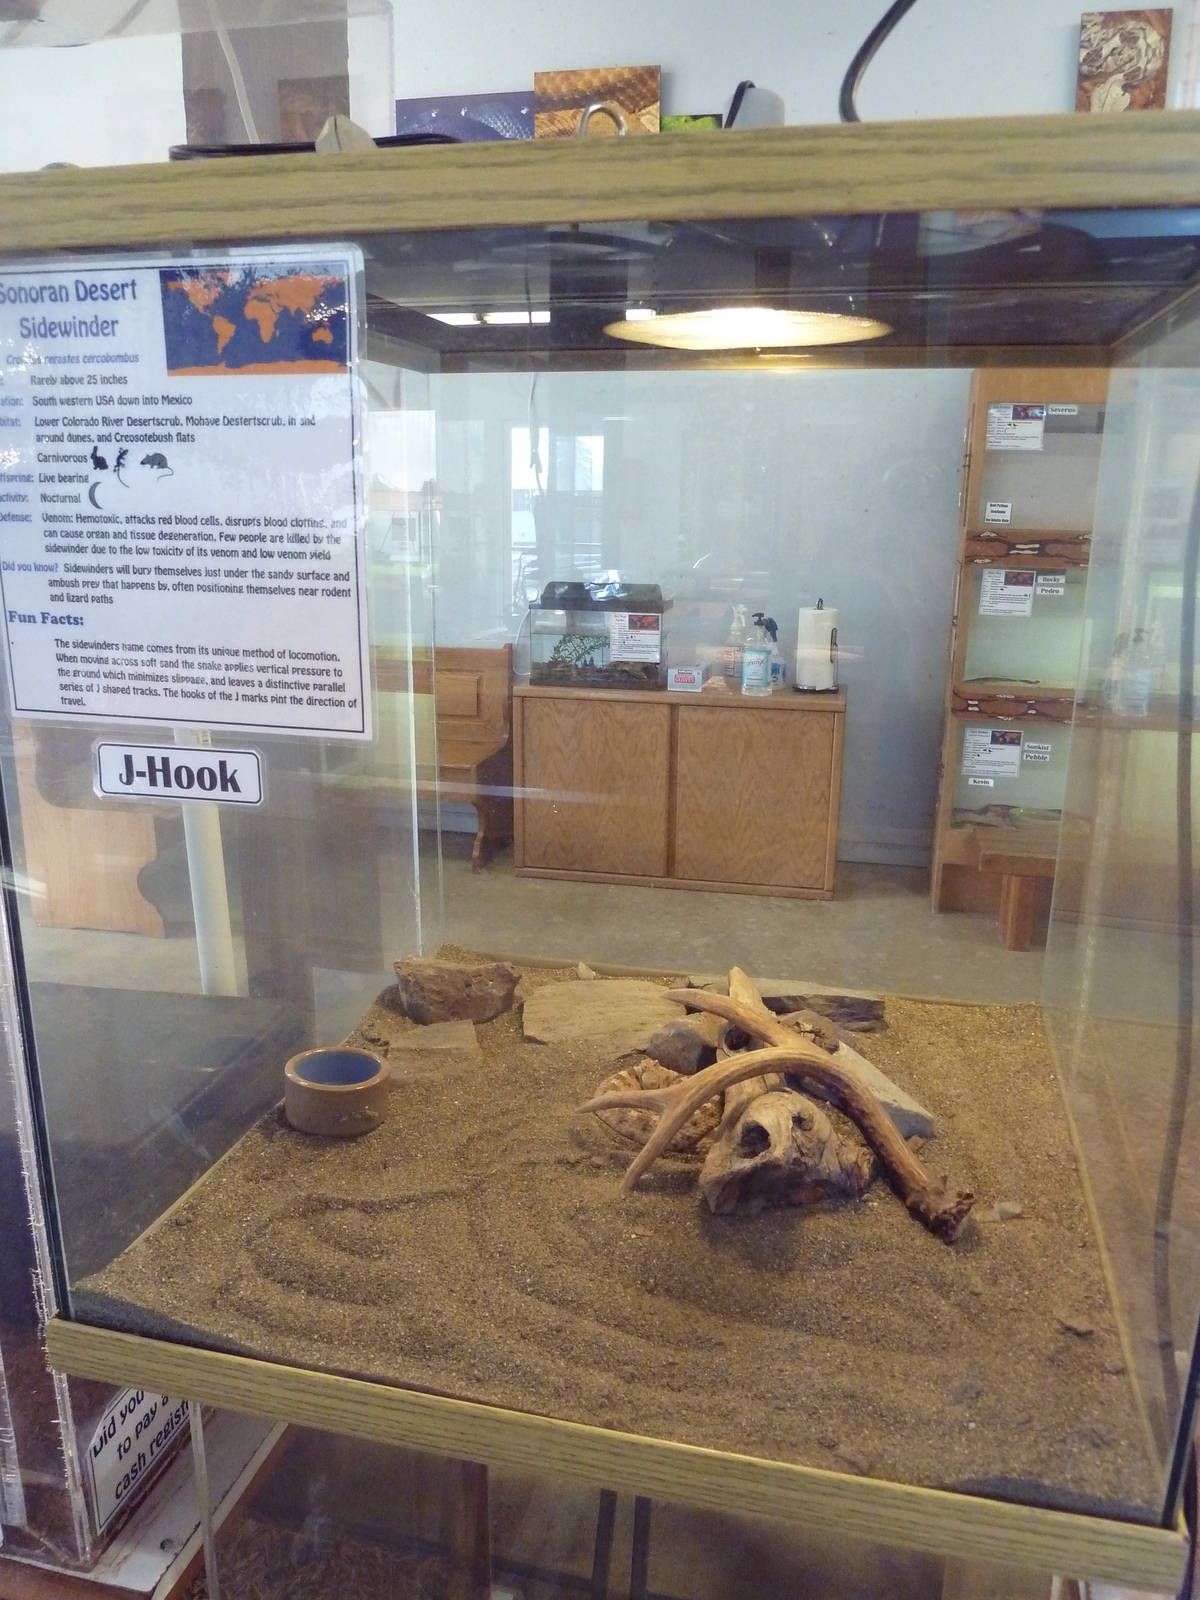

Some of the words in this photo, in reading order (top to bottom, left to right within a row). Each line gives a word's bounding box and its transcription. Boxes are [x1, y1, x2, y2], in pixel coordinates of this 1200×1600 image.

[0, 281, 69, 305] Sonoran
[75, 279, 138, 302] Desert
[20, 314, 119, 339] Sidewinder
[30, 375, 57, 387] Rarely
[60, 375, 85, 386] above
[87, 374, 98, 385] 25
[100, 373, 128, 386] inches
[32, 394, 58, 407] South
[60, 396, 93, 407] western
[95, 394, 115, 406] USA
[118, 394, 140, 406] down
[142, 394, 159, 406] into
[161, 394, 193, 406] Mexico
[34, 415, 60, 428] Lower
[62, 415, 99, 427] Colorado
[102, 415, 124, 427] River
[185, 415, 220, 427] Mohave
[288, 415, 297, 427] in
[299, 415, 316, 427] and
[36, 432, 65, 444] around
[97, 431, 112, 443] and
[114, 431, 173, 444] Creosotebush
[175, 431, 196, 444] flats
[37, 451, 88, 464] Carnivorous
[38, 472, 56, 484] Live
[58, 472, 89, 485] bearing
[40, 492, 81, 504] Nocturnal
[42, 512, 74, 524] Venom:
[125, 514, 156, 526] attacks
[158, 515, 173, 526] red
[175, 515, 198, 527] blood
[225, 516, 261, 528] disrupts
[263, 516, 288, 528] blood
[43, 530, 58, 539] can
[60, 530, 85, 540] cause
[86, 531, 111, 541] organ
[112, 529, 127, 540] and
[130, 530, 156, 541] tissue
[219, 531, 237, 542] Few
[238, 533, 267, 545] people
[269, 535, 285, 544] are
[286, 532, 310, 544] killed
[312, 534, 324, 546] by
[326, 534, 342, 545] the
[44, 542, 89, 554] sidewinder
[91, 543, 106, 555] due
[108, 545, 118, 555] to
[119, 545, 133, 556] the
[135, 545, 150, 556] low
[152, 545, 184, 558] toxicity
[186, 546, 195, 557] of
[197, 547, 208, 558] its
[210, 549, 239, 559] venom
[241, 548, 258, 559] and
[259, 548, 275, 559] low
[277, 550, 307, 560] venom
[309, 549, 332, 561] yield
[2, 561, 16, 572] Did
[17, 563, 32, 573] you
[34, 562, 58, 573] know?
[63, 562, 114, 575] Sidewinders
[116, 563, 131, 575] will
[132, 564, 152, 576] bury
[154, 565, 202, 578] themselves
[204, 566, 221, 578] just
[223, 567, 249, 580] under
[251, 569, 265, 580] the
[267, 569, 294, 582] sandy
[296, 570, 331, 582] surface
[333, 570, 350, 582] and
[48, 578, 80, 589] ambush
[82, 580, 99, 591] prey
[102, 579, 119, 591] that
[121, 580, 156, 592] happens
[171, 581, 195, 593] often
[197, 582, 244, 595] positioning
[246, 583, 296, 597] themselves
[298, 586, 318, 597] near
[321, 586, 352, 598] rodent
[49, 591, 65, 603] and
[66, 592, 89, 604] lizard
[90, 593, 114, 605] paths
[8, 610, 37, 624] Fun
[41, 612, 85, 626] Facts:
[54, 638, 70, 649] The
[71, 639, 120, 652] sidewinders
[122, 643, 145, 652] name
[147, 644, 174, 654] comes
[175, 643, 197, 655] from
[198, 644, 210, 656] its
[211, 646, 241, 658] unique
[242, 647, 275, 660] method
[276, 648, 287, 660] of
[288, 649, 341, 663] locomotion.
[55, 652, 79, 664] When
[80, 655, 109, 666] moving
[111, 657, 139, 667] across
[140, 656, 158, 668] soft
[159, 657, 179, 669] sand
[181, 659, 195, 670] the
[197, 660, 222, 672] snake
[224, 661, 255, 674] applies
[256, 663, 290, 676] vertical
[291, 666, 331, 679] pressure
[333, 666, 343, 678] to
[57, 667, 71, 678] the
[72, 669, 101, 680] ground
[102, 670, 127, 681] which
[128, 671, 169, 684] minimizes
[210, 675, 226, 687] and
[228, 676, 256, 689] leaves
[257, 679, 263, 689] a
[265, 678, 311, 692] distinctive
[312, 681, 346, 694] parallel
[59, 681, 83, 693] series
[85, 682, 94, 694] of
[102, 684, 131, 697] shaped
[132, 685, 162, 698] tracks.
[163, 687, 179, 699] The
[180, 688, 206, 700] hooks
[207, 689, 217, 701] of
[219, 690, 233, 702] the
[241, 692, 269, 704] marks
[270, 693, 288, 706] pint
[289, 695, 304, 707] the
[306, 695, 346, 709] direction
[347, 697, 358, 709] of
[60, 695, 87, 706] travel.
[119, 754, 242, 794] J-Hook
[120, 1390, 144, 1425] you
[116, 1436, 132, 1461] to
[135, 1401, 158, 1440] pay
[115, 1452, 147, 1500] cash
